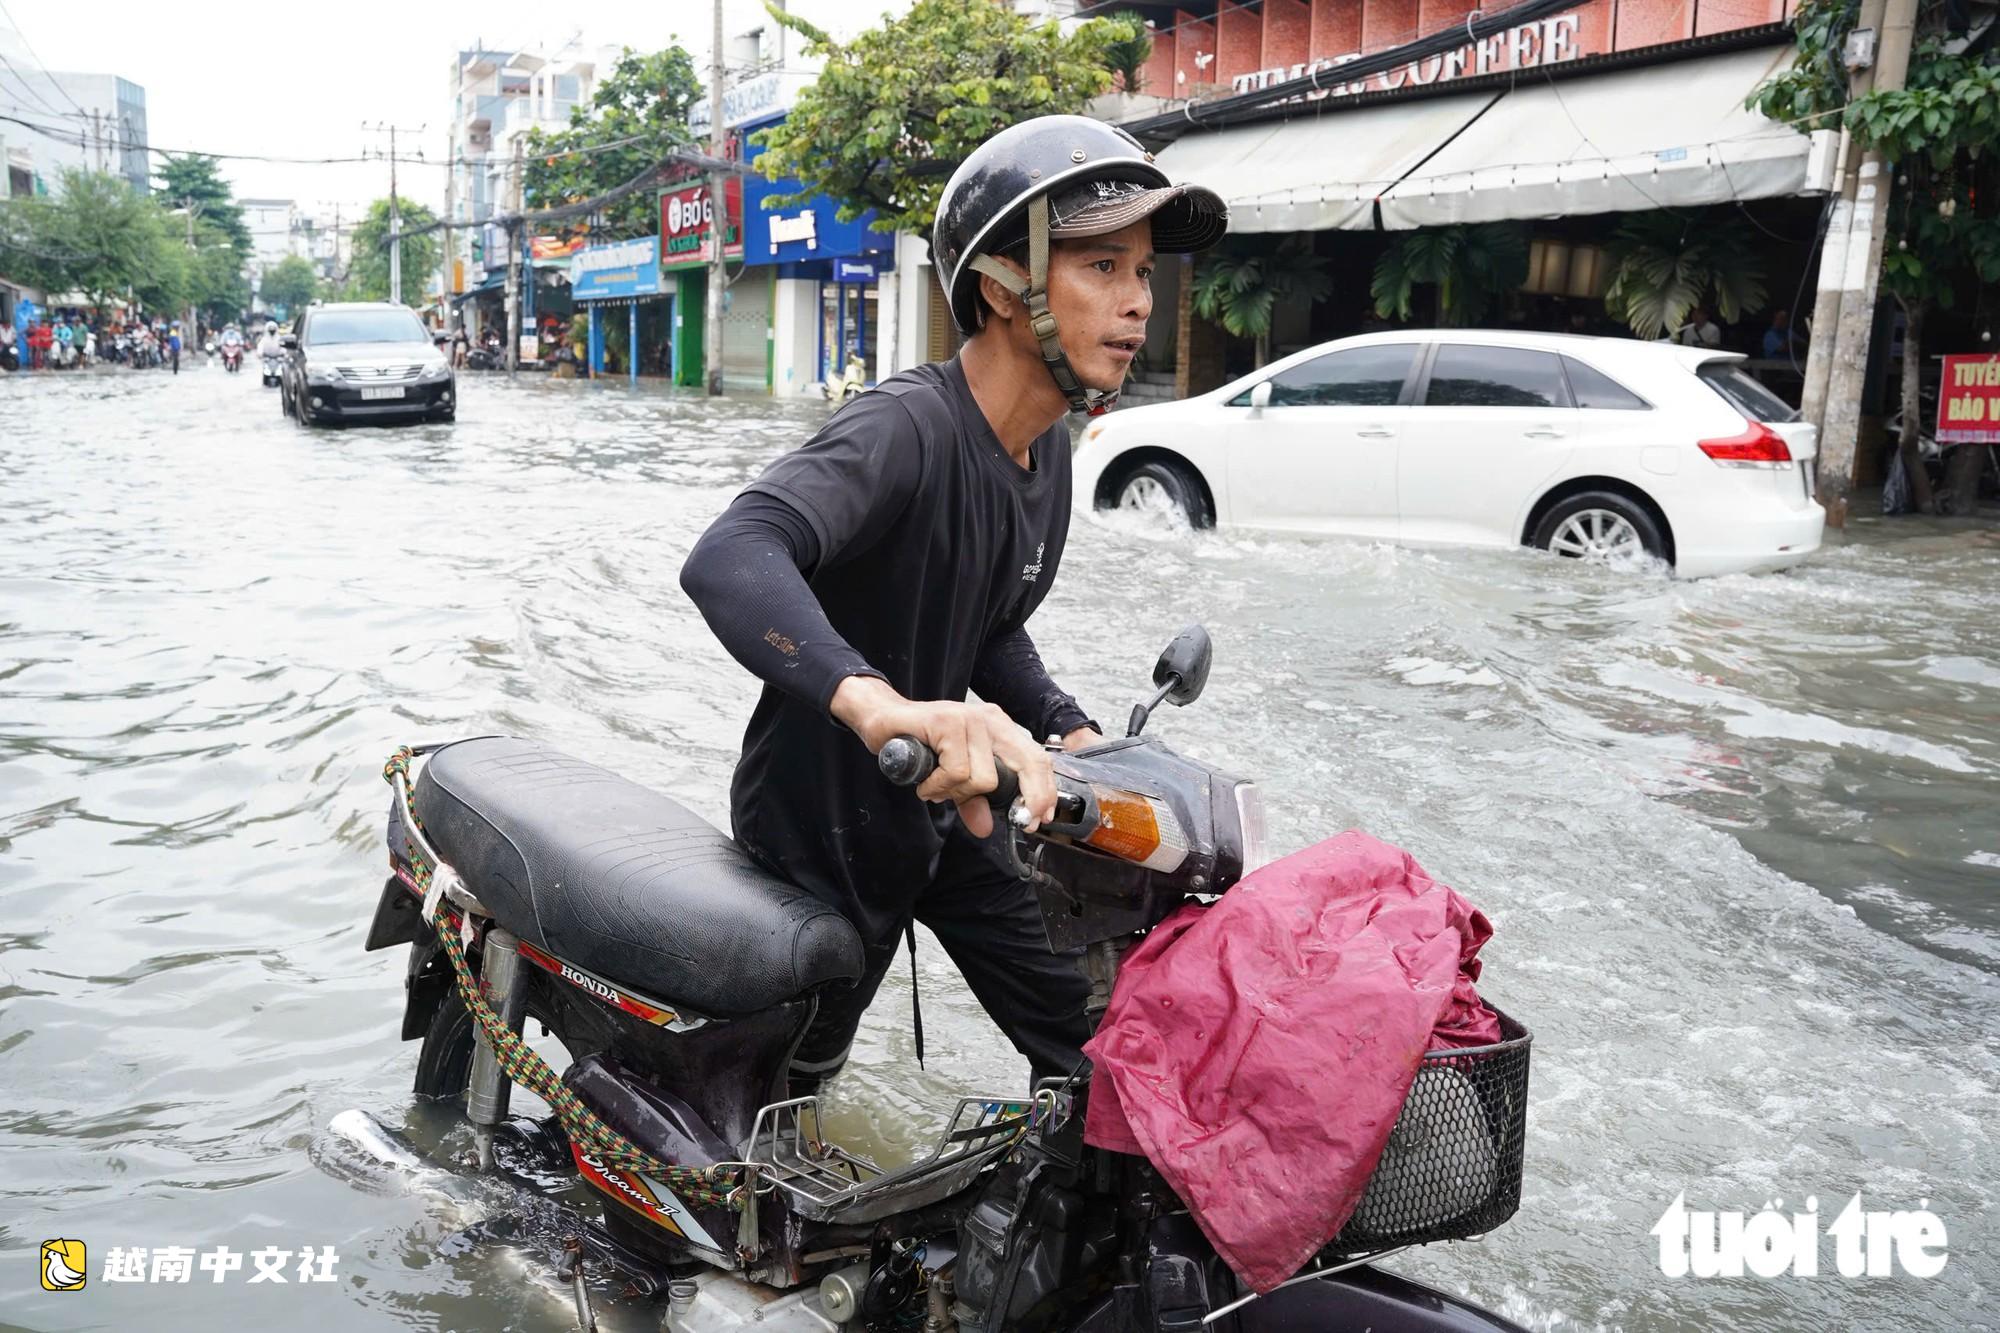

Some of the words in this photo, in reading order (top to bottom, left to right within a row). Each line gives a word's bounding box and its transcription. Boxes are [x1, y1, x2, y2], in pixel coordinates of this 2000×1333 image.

[1376, 14, 1581, 93] COFFEE
[1948, 392, 1985, 421] BẢO
[560, 964, 621, 1004] HONDA
[581, 1153, 656, 1207] Dream
